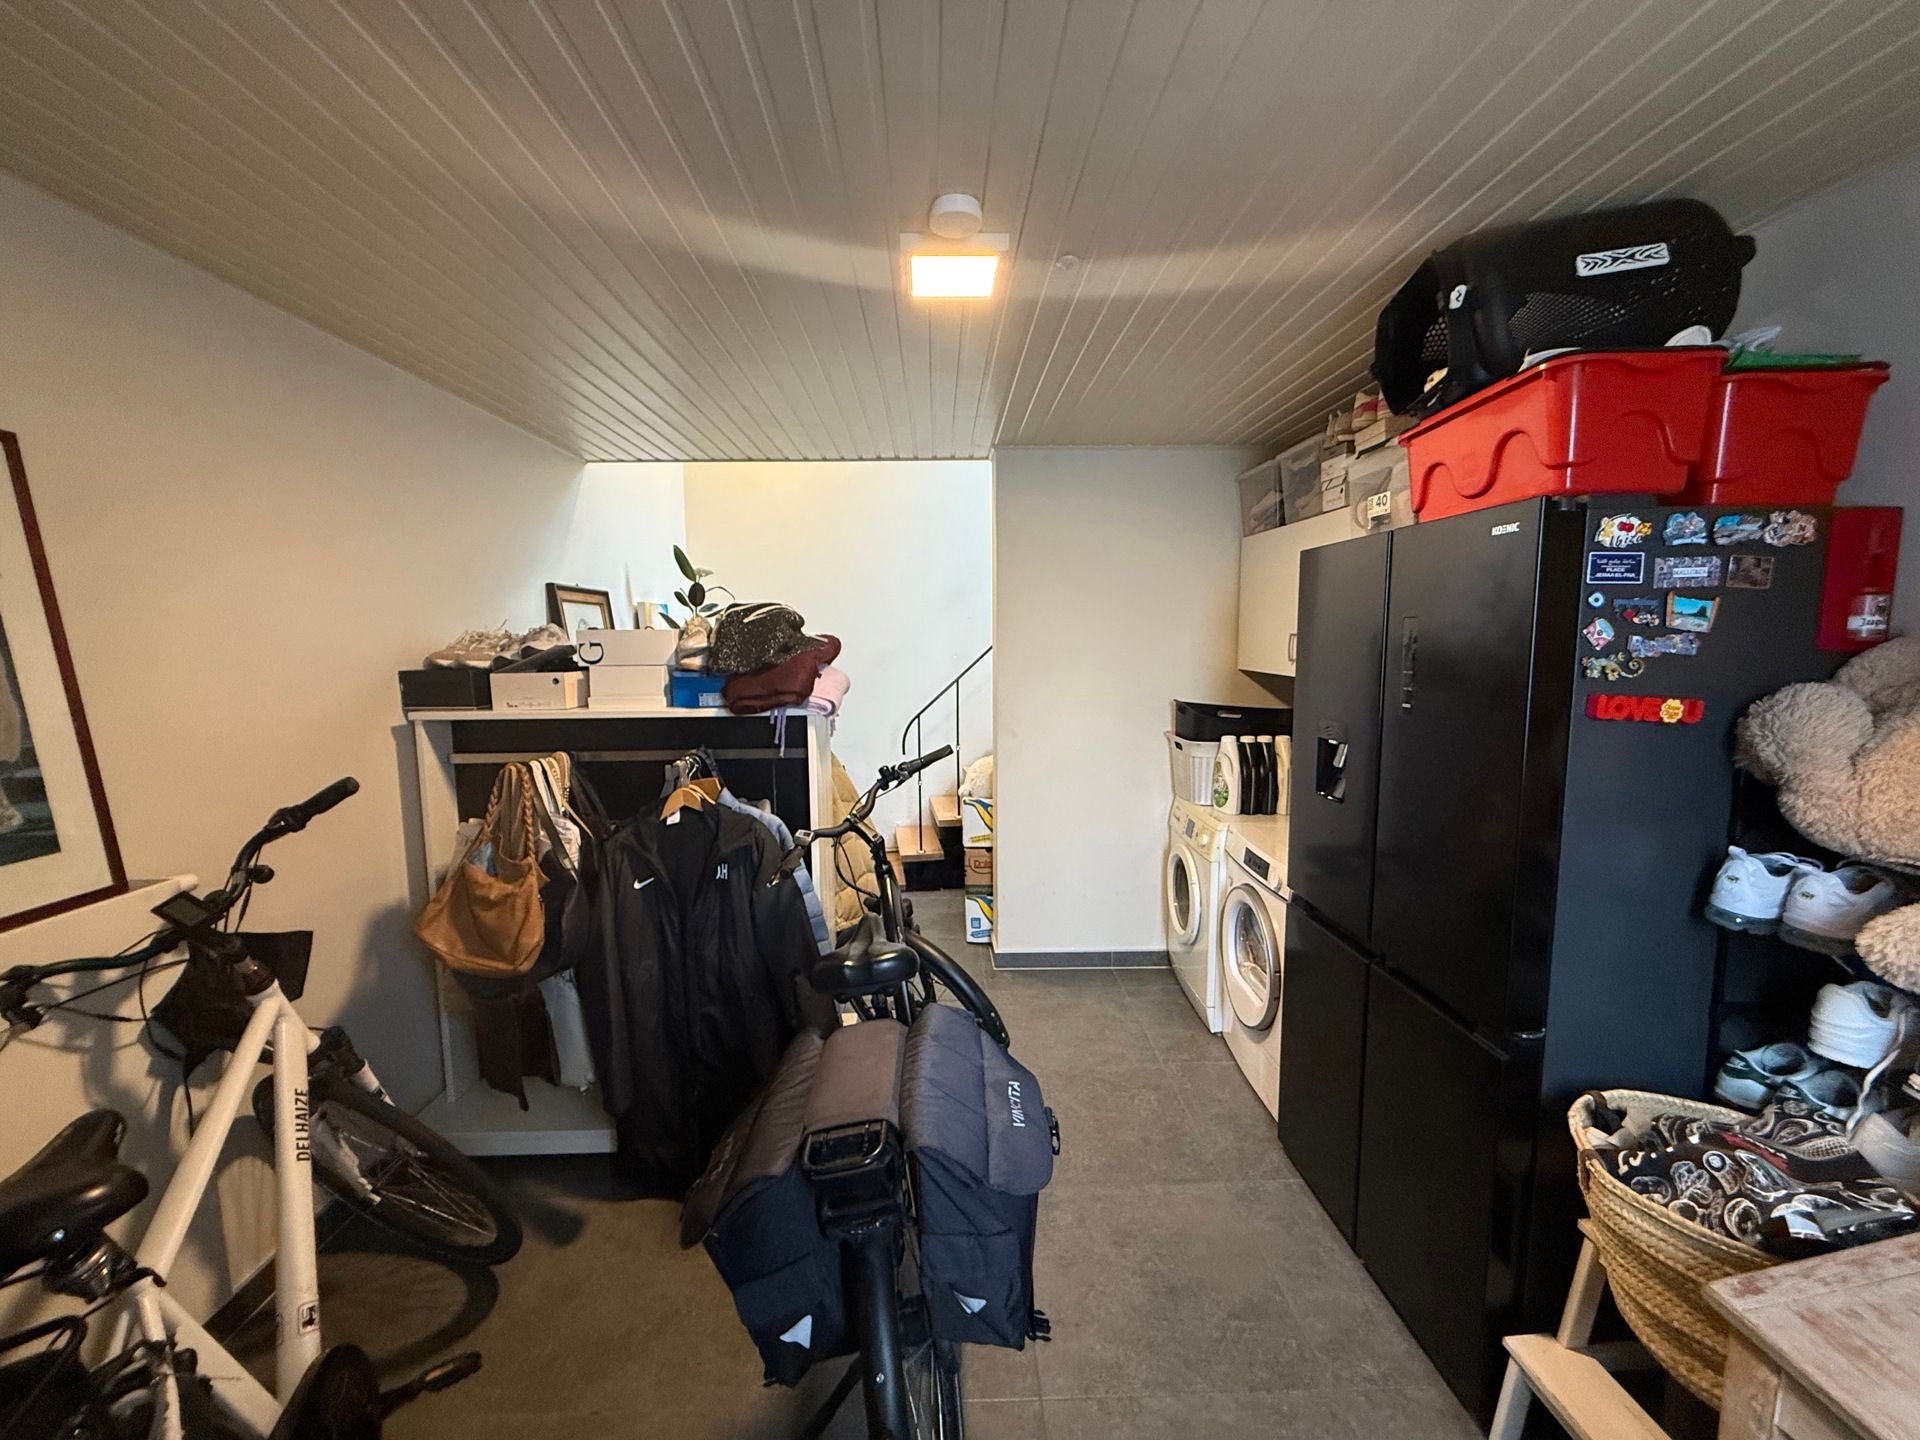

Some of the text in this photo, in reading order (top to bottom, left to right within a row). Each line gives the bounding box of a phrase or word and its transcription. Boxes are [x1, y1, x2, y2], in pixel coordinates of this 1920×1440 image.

[1375, 493, 1388, 508] 40
[1491, 519, 1520, 536] KOENIC
[578, 640, 604, 665] G
[1596, 693, 1662, 722] LOVE
[1007, 1080, 1026, 1127] VINCITA
[294, 1088, 310, 1162] DELHAIZE
